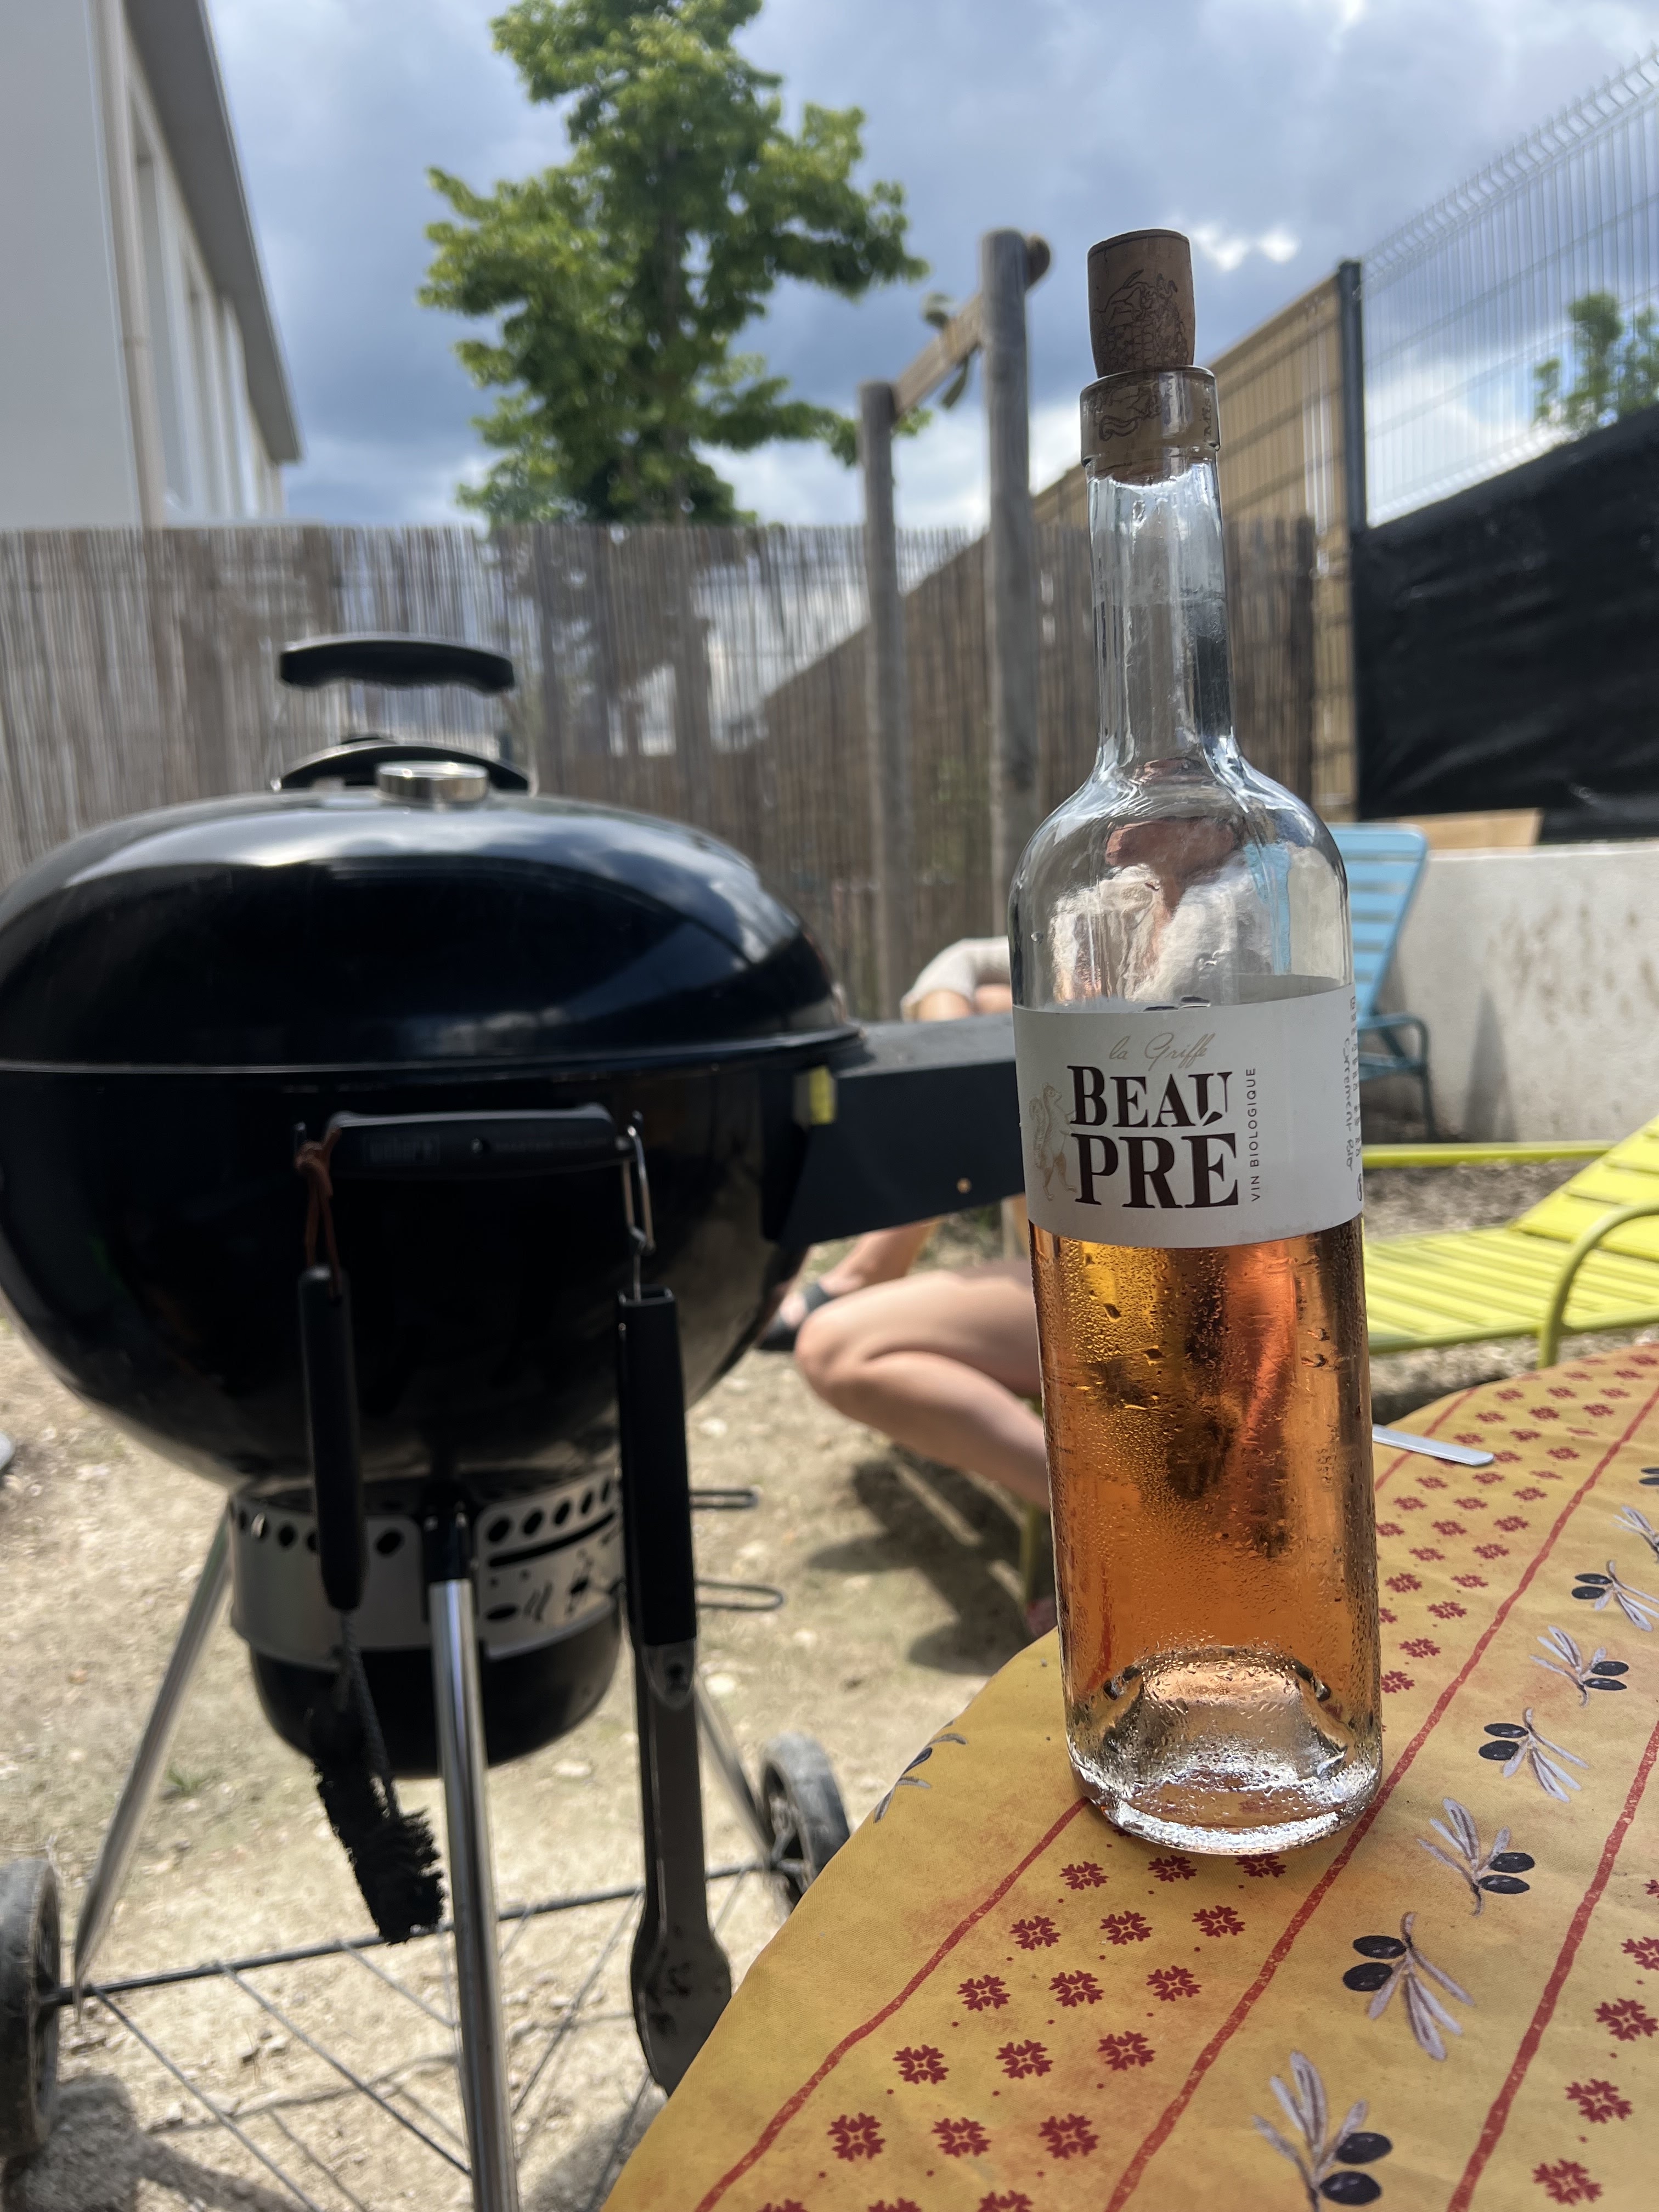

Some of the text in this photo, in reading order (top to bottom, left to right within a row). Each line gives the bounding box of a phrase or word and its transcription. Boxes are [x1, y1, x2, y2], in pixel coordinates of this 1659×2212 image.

[1109, 1032, 1216, 1071] la Griffe
[1066, 1065, 1233, 1127] BEAU
[1245, 1068, 1260, 1202] VIN BIOLOGIQUE
